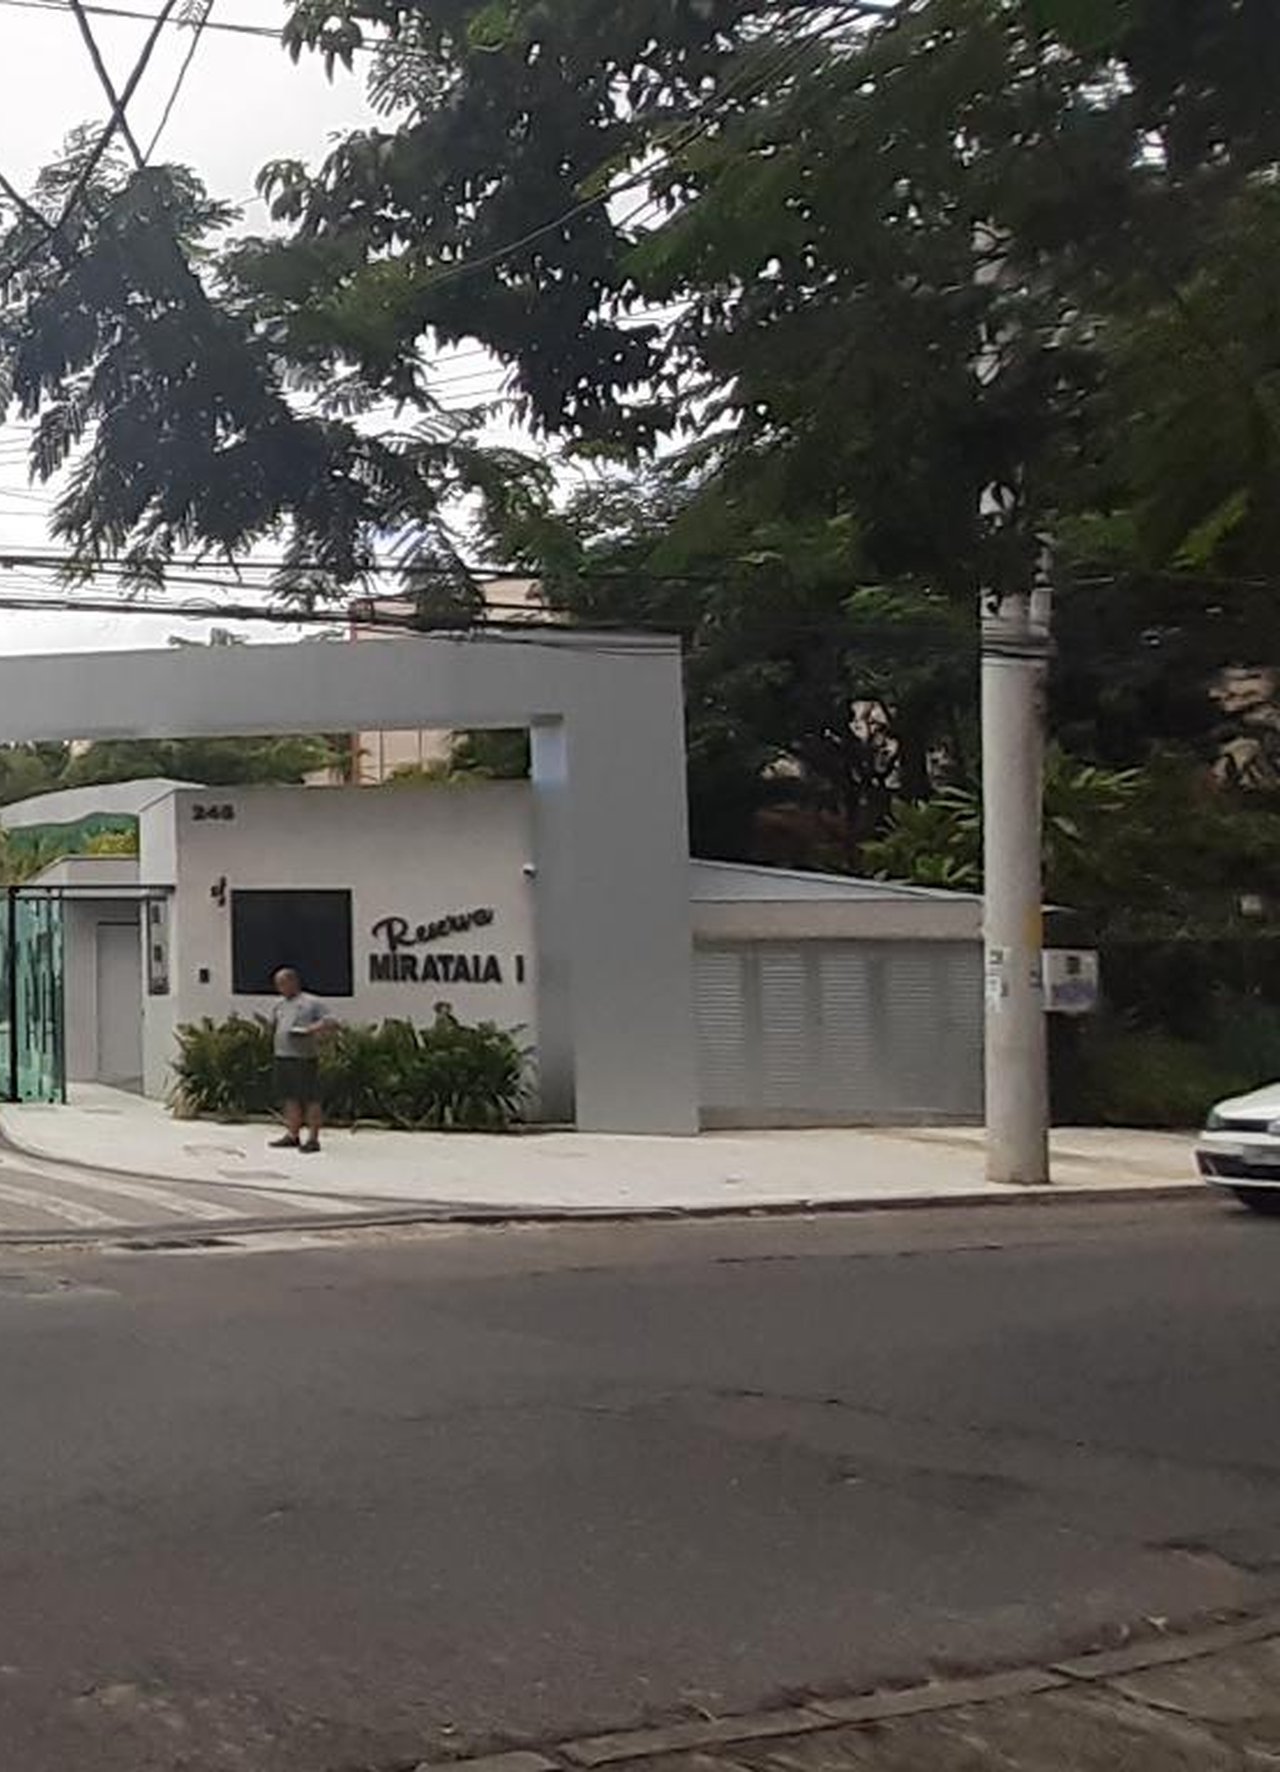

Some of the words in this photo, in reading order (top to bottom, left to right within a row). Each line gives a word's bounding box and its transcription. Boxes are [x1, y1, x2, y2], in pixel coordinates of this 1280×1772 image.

[371, 908, 494, 951] Reserva
[368, 953, 502, 984] MIRATAIA
[515, 954, 526, 984] I
